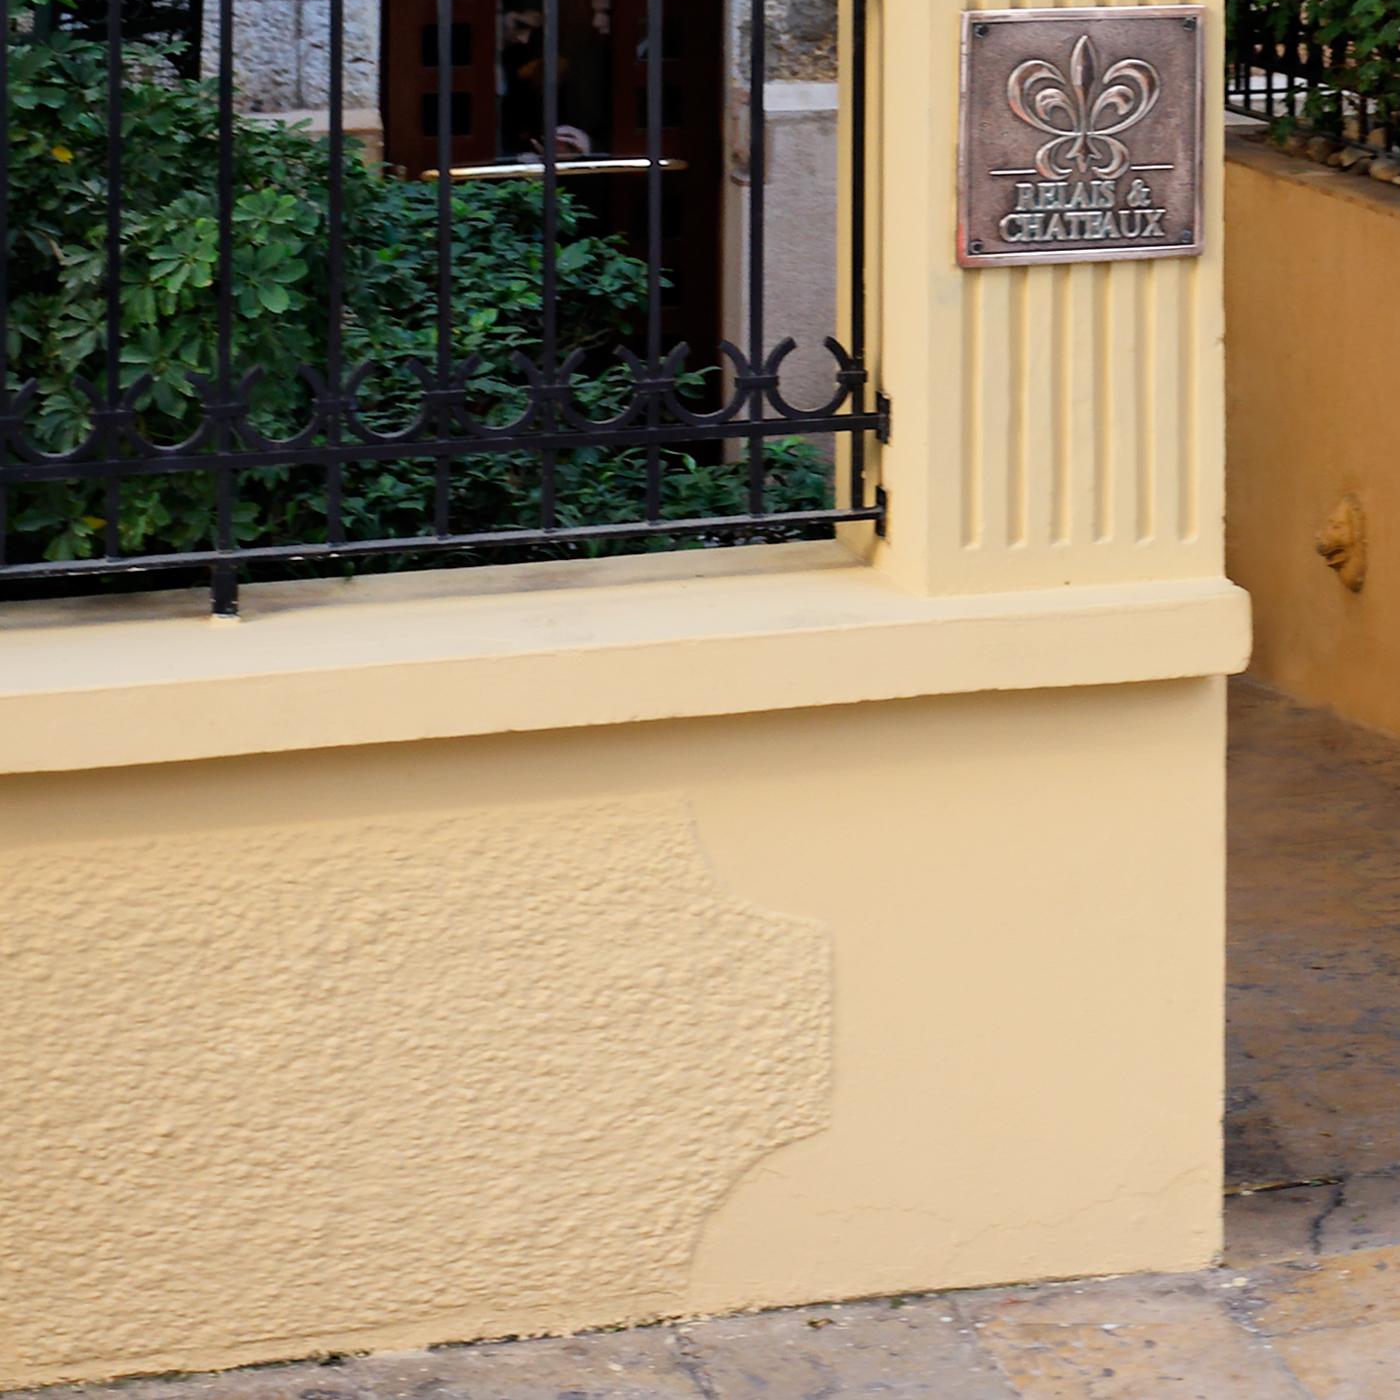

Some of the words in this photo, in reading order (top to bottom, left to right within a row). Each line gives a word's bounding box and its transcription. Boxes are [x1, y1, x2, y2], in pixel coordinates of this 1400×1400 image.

[1014, 180, 1116, 210] RELAIS
[1126, 178, 1153, 208] &
[998, 209, 1167, 243] CHATEAUX
